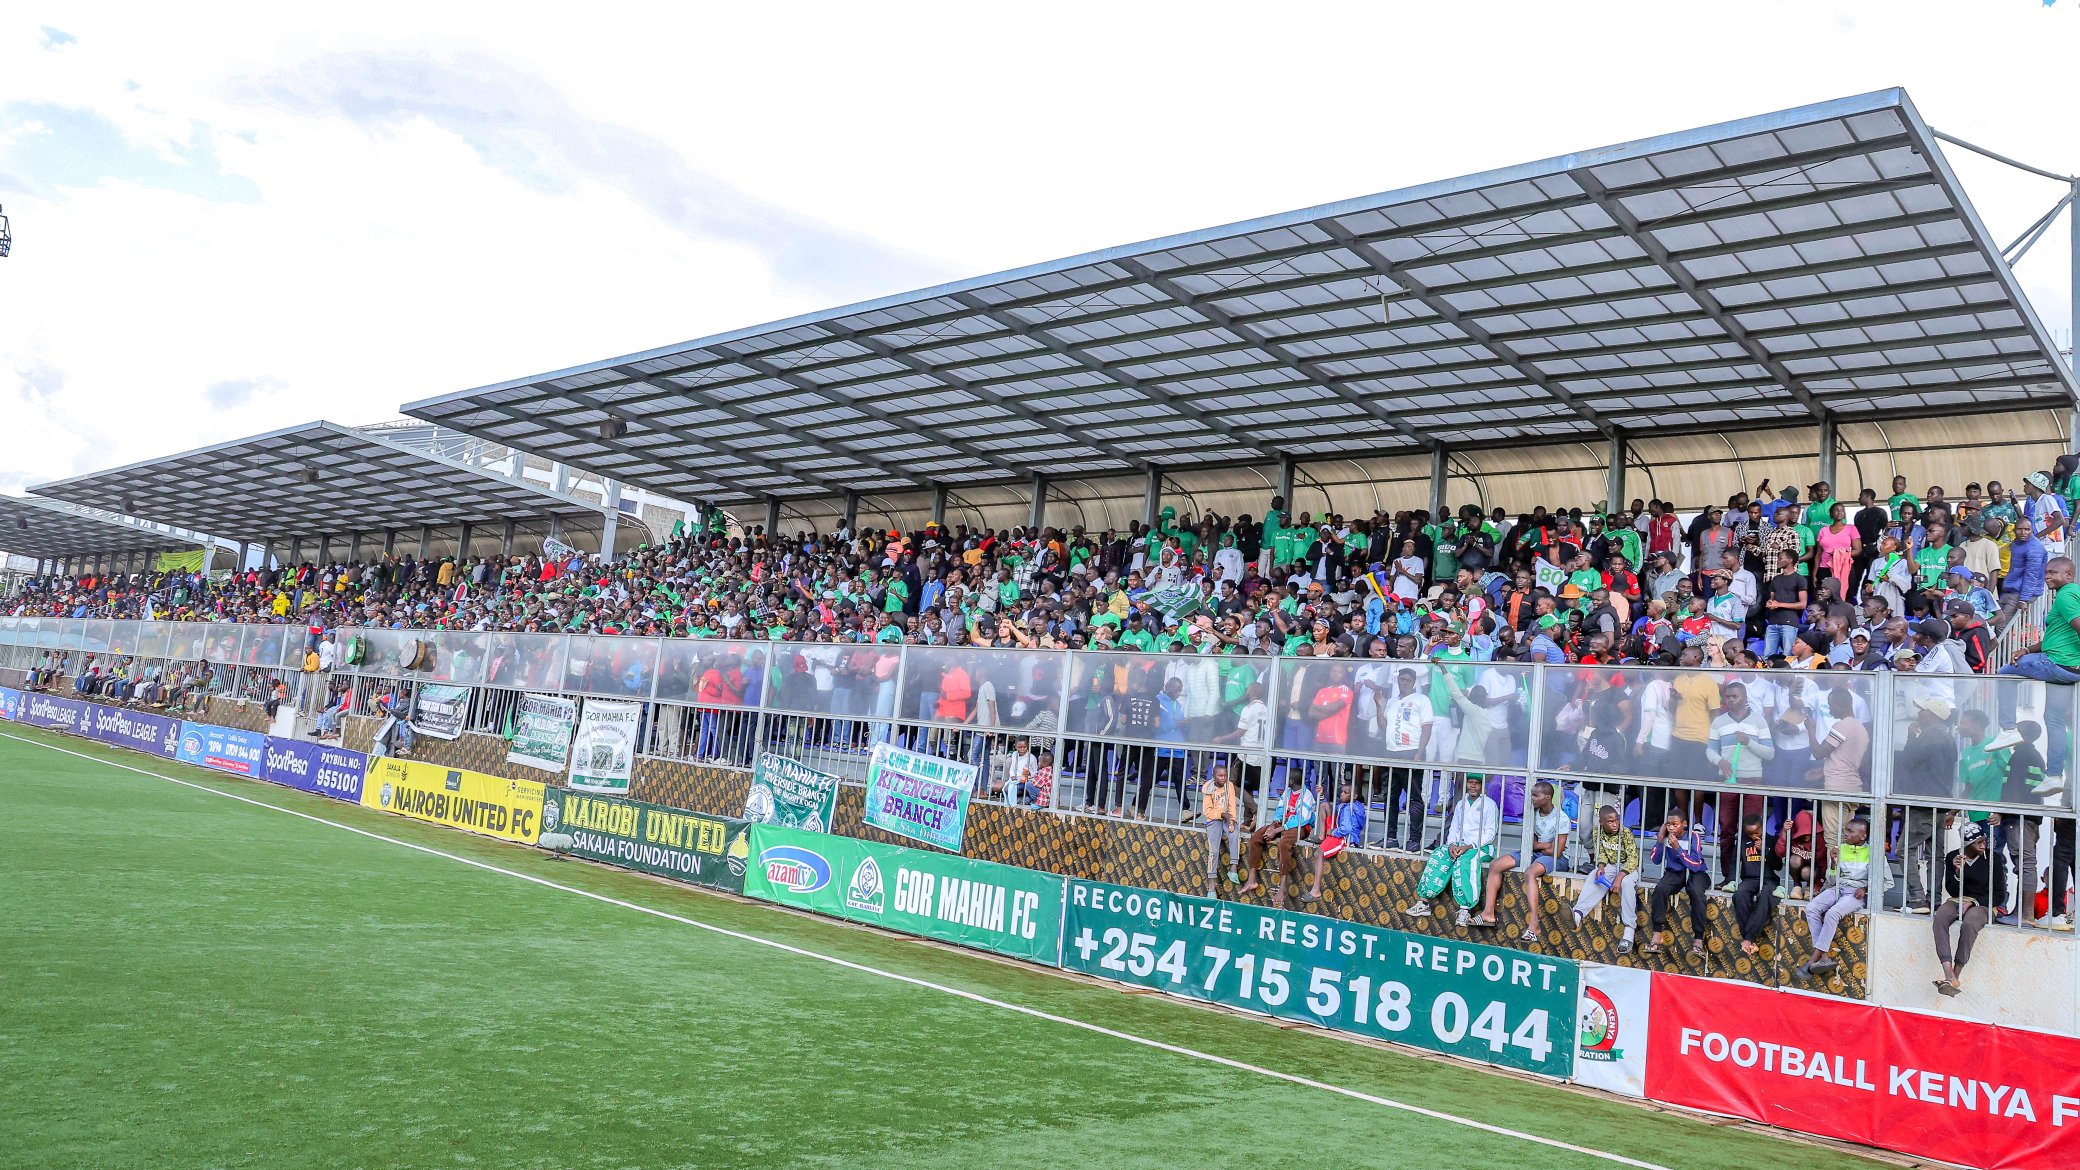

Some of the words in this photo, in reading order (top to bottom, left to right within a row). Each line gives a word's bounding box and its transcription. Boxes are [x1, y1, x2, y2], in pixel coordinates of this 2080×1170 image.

[1538, 567, 1564, 586] 80
[56, 706, 77, 724] LEAGUE
[96, 708, 130, 735] SportPesa
[132, 721, 158, 742] LEAGUE
[601, 712, 624, 722] MAHIA
[266, 746, 308, 776] SportPesa
[320, 752, 346, 768] PAYBILL
[348, 758, 361, 770] NO:
[888, 752, 910, 771] GOR
[945, 766, 960, 785] FC
[316, 768, 358, 794] 955100
[764, 770, 797, 794] RIVERSIDE
[780, 760, 818, 788] MAHIA
[876, 768, 958, 810] KITENGELA
[393, 786, 450, 820] NAIROBI
[452, 796, 508, 832] UNITED
[511, 808, 534, 838] FC
[882, 794, 944, 830] BRANCH
[562, 795, 640, 840] NAIROBI
[644, 809, 727, 856] UNITED
[572, 830, 616, 857] SAKAJA
[618, 840, 702, 875] FOUNDATION
[894, 866, 934, 918] GOR
[938, 876, 1006, 934] MAHIA
[1010, 888, 1040, 940] FC
[1721, 910, 1734, 925] TREE
[1779, 917, 1789, 930] REE
[1073, 884, 1242, 934] RECOGNIZE.
[1258, 916, 1386, 962] RESIST.
[1405, 940, 1568, 994] REPORT.
[1584, 924, 1596, 938] TREE
[1677, 936, 1690, 951] TREE
[1712, 919, 1731, 943] SOURCE
[1574, 933, 1593, 955] SOURCE
[1608, 943, 1620, 957] TREE
[1726, 943, 1739, 959] TREE
[1782, 948, 1795, 964] TREE
[1839, 936, 1860, 962] SOURCE
[1667, 946, 1685, 969] SOURCE
[1716, 953, 1735, 977] SOURCE
[1754, 964, 1768, 980] TREE
[1835, 955, 1849, 972] TREE
[1845, 972, 1866, 998] SOURCE
[1074, 927, 1188, 986] +254
[1203, 944, 1290, 1008] 715
[1306, 968, 1412, 1034] 518
[1431, 990, 1552, 1064] 044
[1606, 1008, 1616, 1040] KENYA
[1680, 1026, 1876, 1092] FOOTBALL
[1888, 1065, 2036, 1123] KENYA
